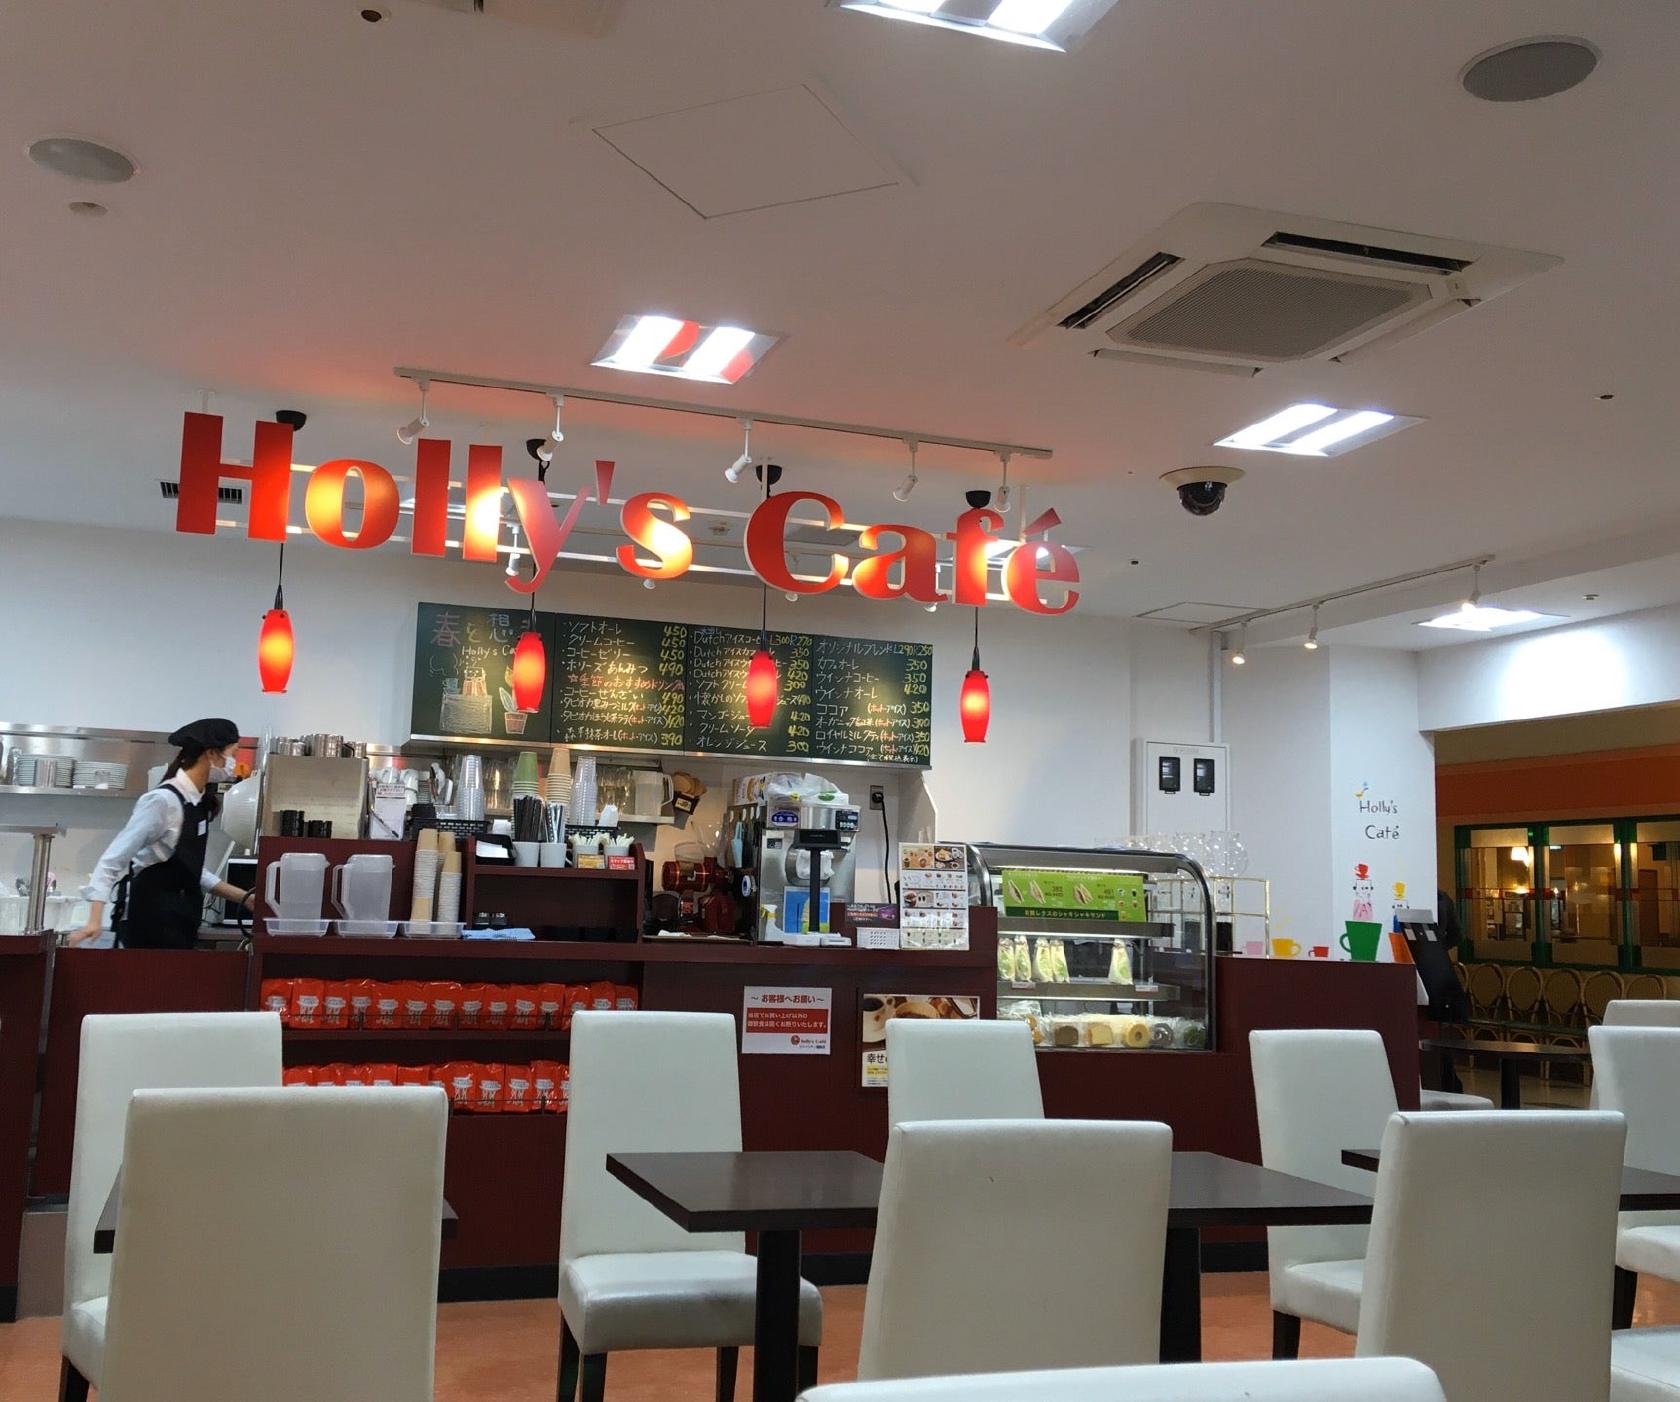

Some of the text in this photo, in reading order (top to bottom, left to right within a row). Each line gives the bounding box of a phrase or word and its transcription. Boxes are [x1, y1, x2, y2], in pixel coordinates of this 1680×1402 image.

[176, 411, 1080, 615] Holly's Café
[569, 621, 687, 638] ソフトオーレ 450
[569, 634, 685, 648] クリームコーヒー 450
[567, 647, 685, 660] コーヒーゼリー 450
[791, 649, 809, 658] 350
[659, 662, 683, 676] 490
[906, 659, 927, 671] 350
[788, 671, 808, 681] 420
[904, 673, 926, 683] 350
[784, 681, 805, 691] 300
[904, 684, 927, 695] 420
[662, 692, 684, 704] 490
[816, 703, 849, 717] ココア
[911, 701, 929, 714] 350
[791, 711, 810, 721] 420
[788, 725, 809, 736] 420
[661, 733, 683, 746] 390
[786, 740, 809, 752] 300
[1360, 800, 1398, 815] Holly's
